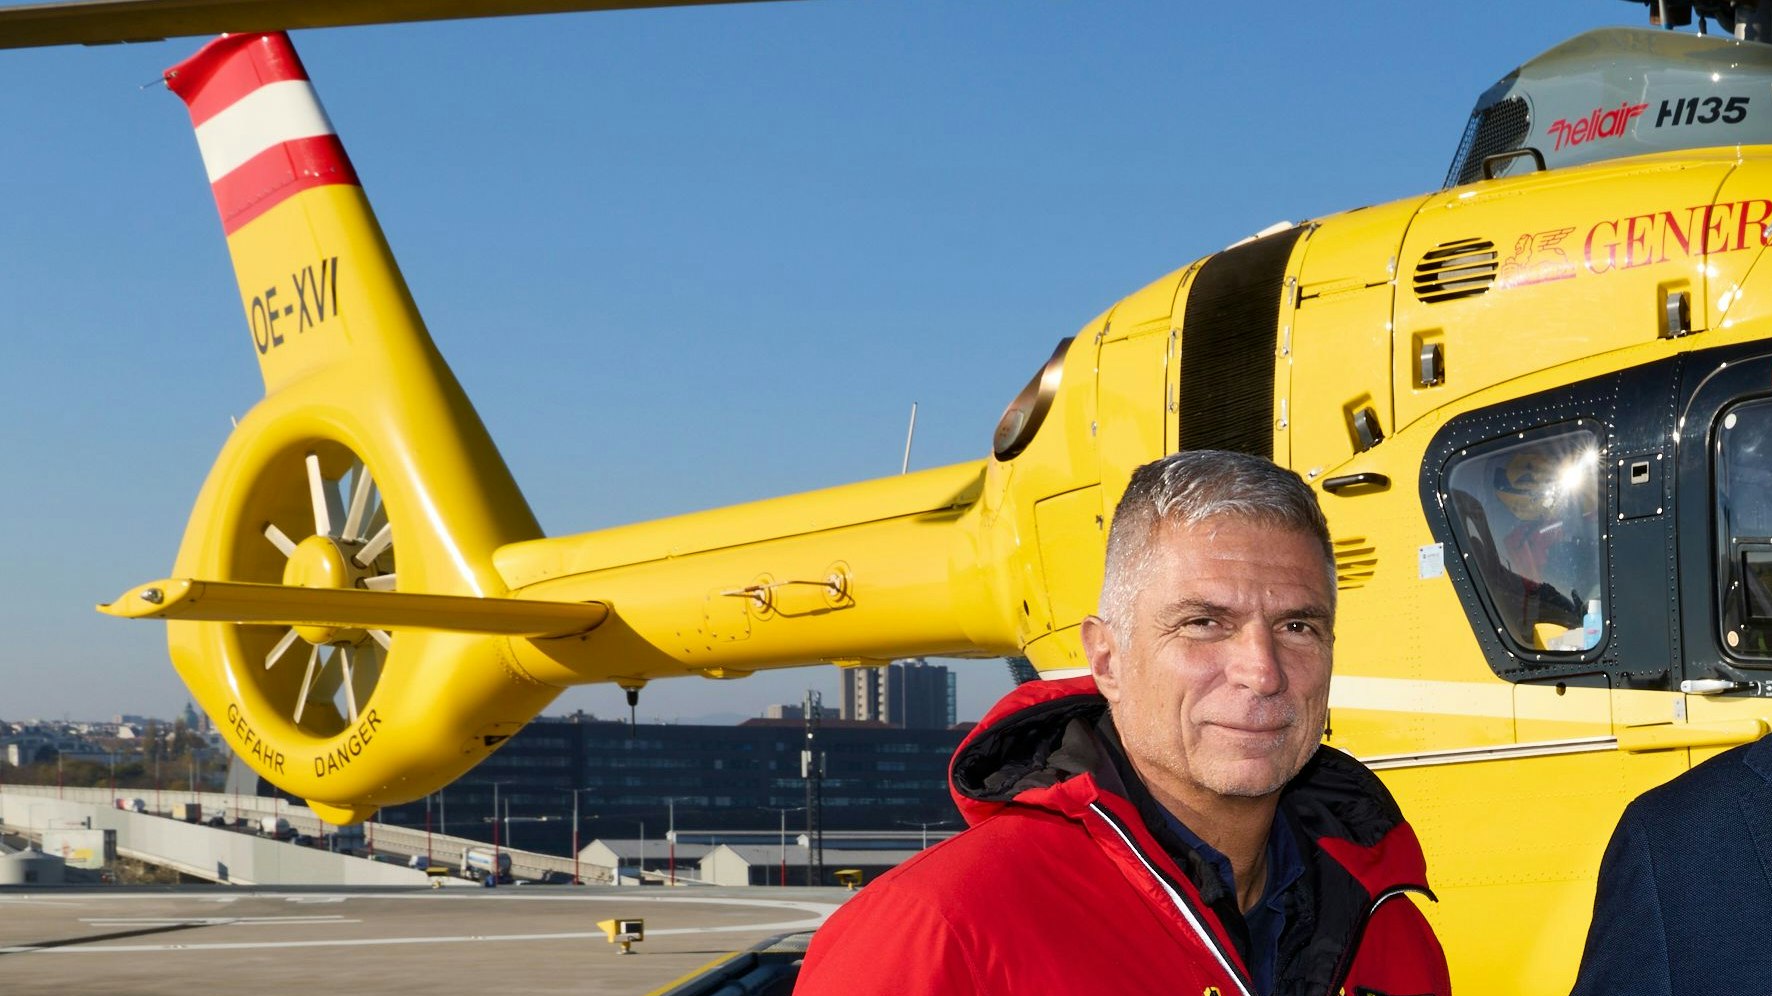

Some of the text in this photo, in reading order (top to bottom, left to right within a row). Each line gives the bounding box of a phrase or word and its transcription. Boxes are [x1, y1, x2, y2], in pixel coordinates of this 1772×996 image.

[1548, 97, 1750, 151] heliair H135
[252, 256, 338, 355] OE-XVI
[227, 703, 382, 778] GEFAHR DANGER
